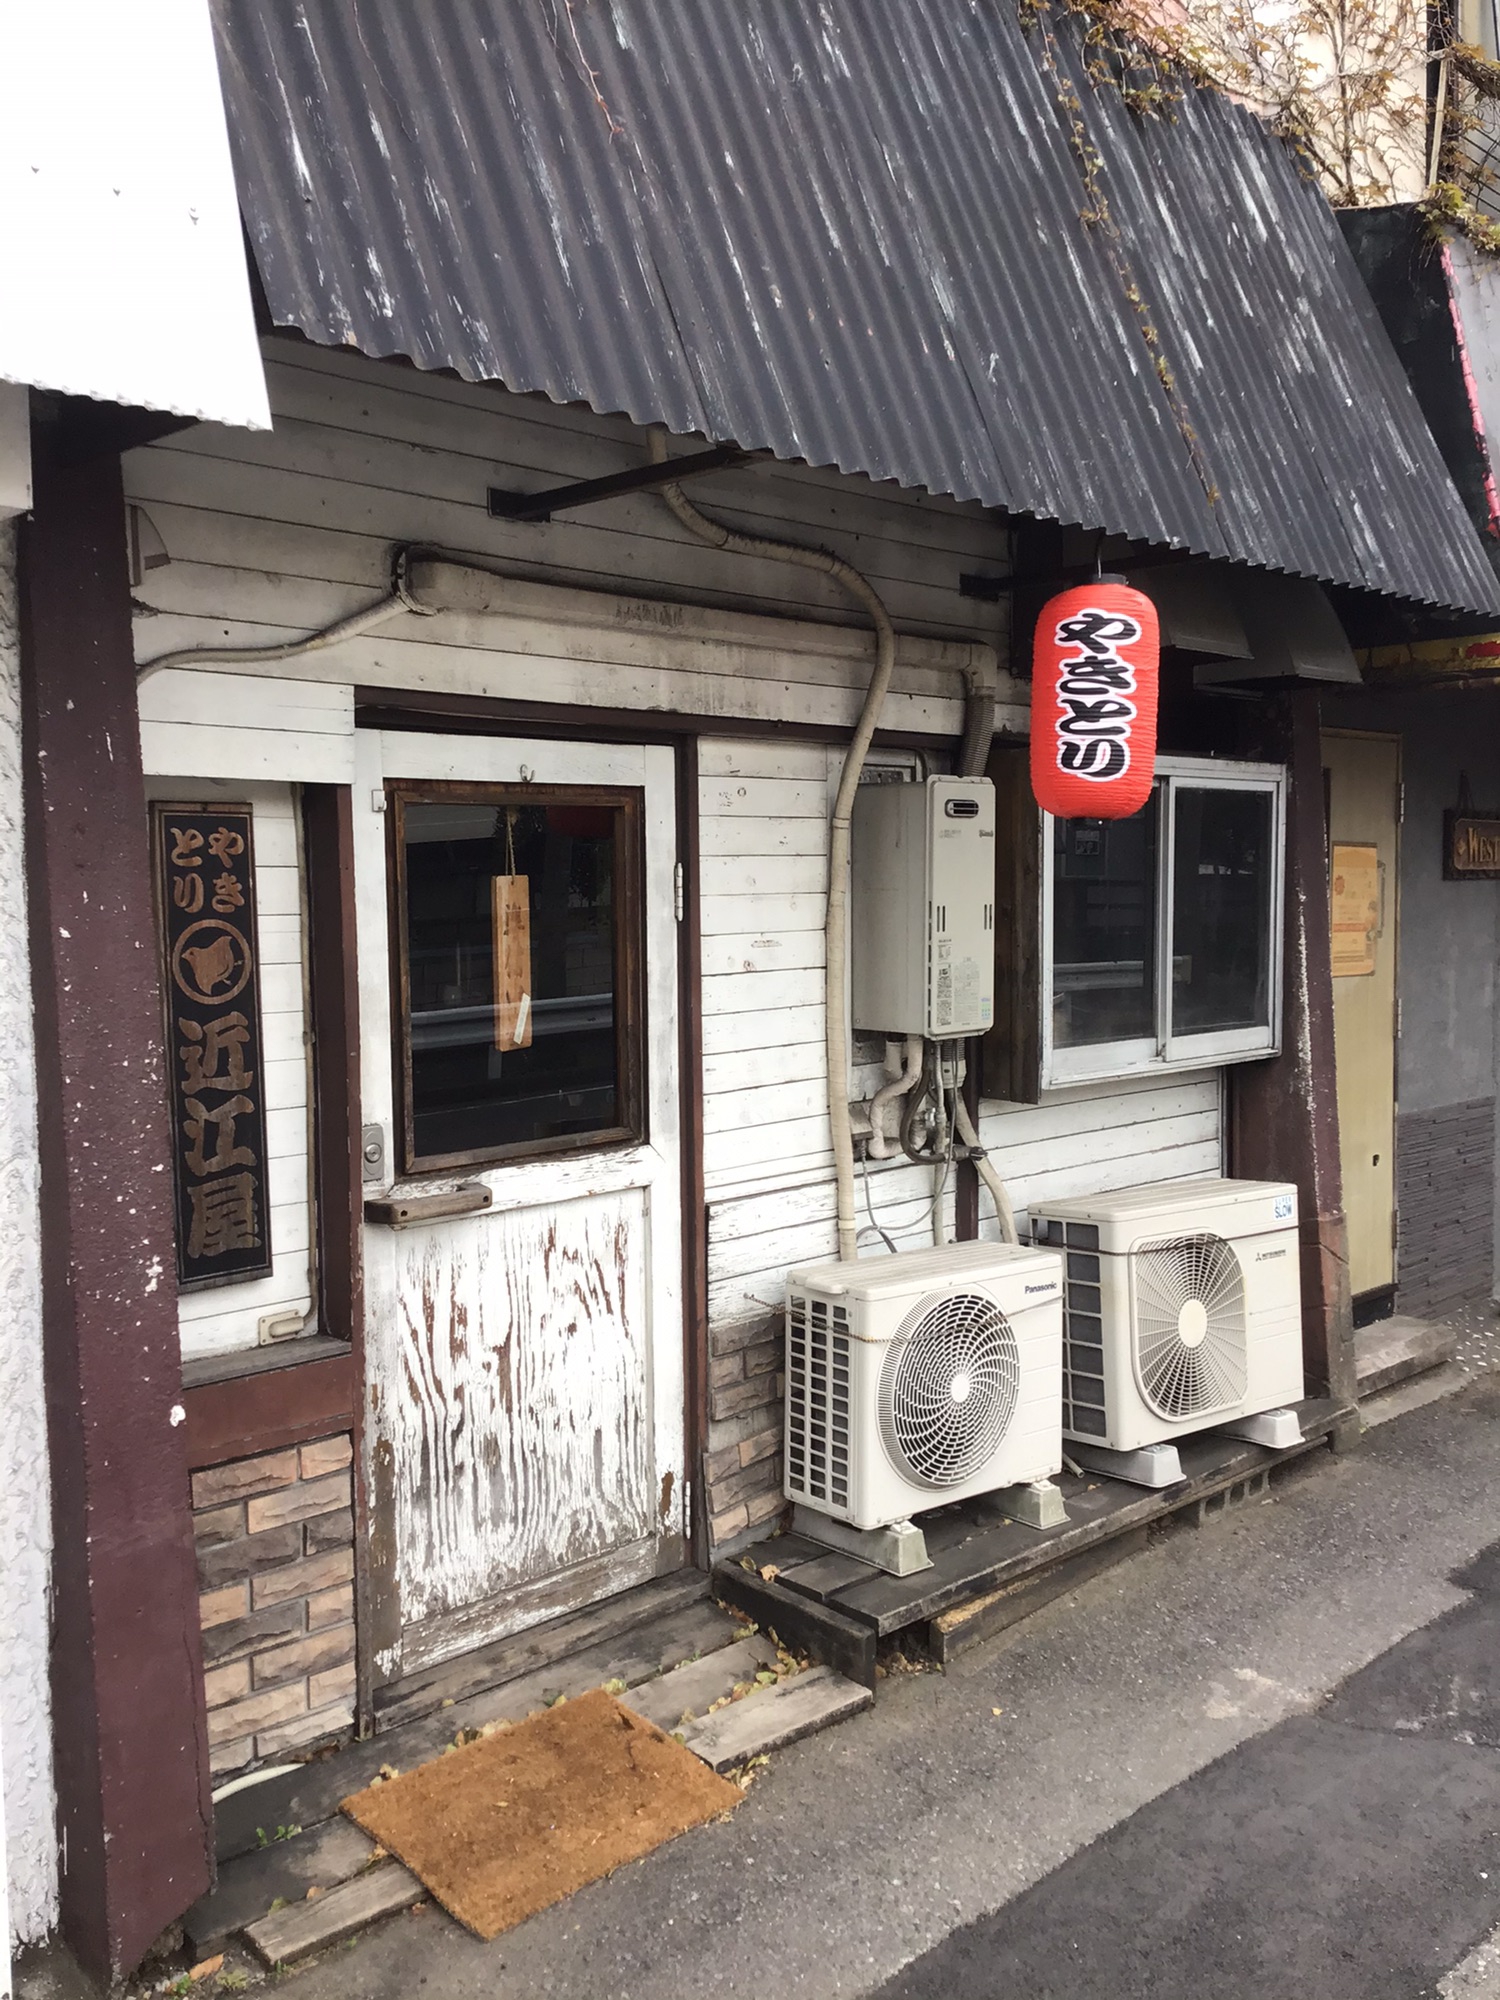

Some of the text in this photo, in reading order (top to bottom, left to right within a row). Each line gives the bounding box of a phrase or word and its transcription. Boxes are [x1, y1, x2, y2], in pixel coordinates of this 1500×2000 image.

[1056, 609, 1141, 781] やきとり
[169, 825, 205, 914] とり
[207, 825, 247, 914] やき
[178, 1010, 263, 1260] 近江屋
[1024, 1281, 1058, 1295] Panasonic
